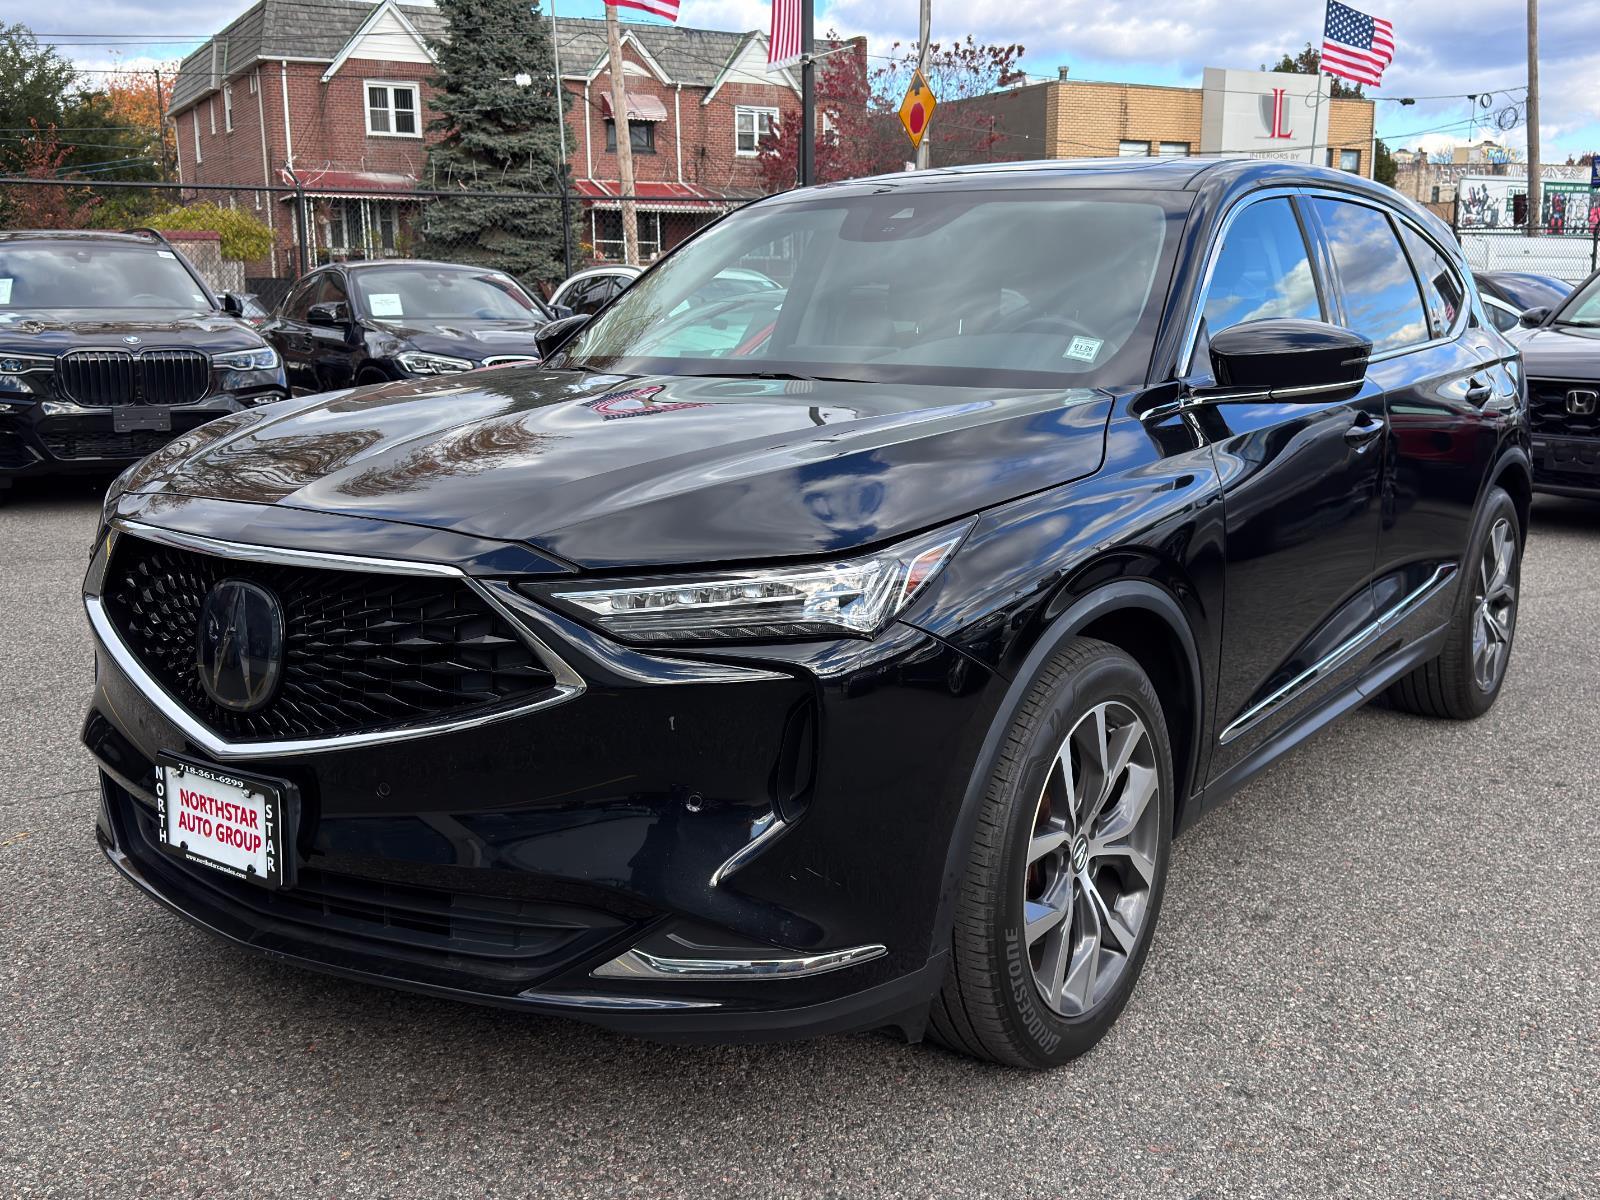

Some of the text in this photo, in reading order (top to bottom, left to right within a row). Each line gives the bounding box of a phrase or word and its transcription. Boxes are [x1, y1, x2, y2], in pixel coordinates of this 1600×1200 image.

[178, 763, 244, 788] 718-361-6299
[155, 766, 167, 844] NORTH
[178, 811, 262, 854] AUTO GROUP
[179, 788, 259, 830] NORTHSTAR
[265, 804, 276, 873] STAR
[1005, 927, 1062, 1055] BRIDGESTONE
